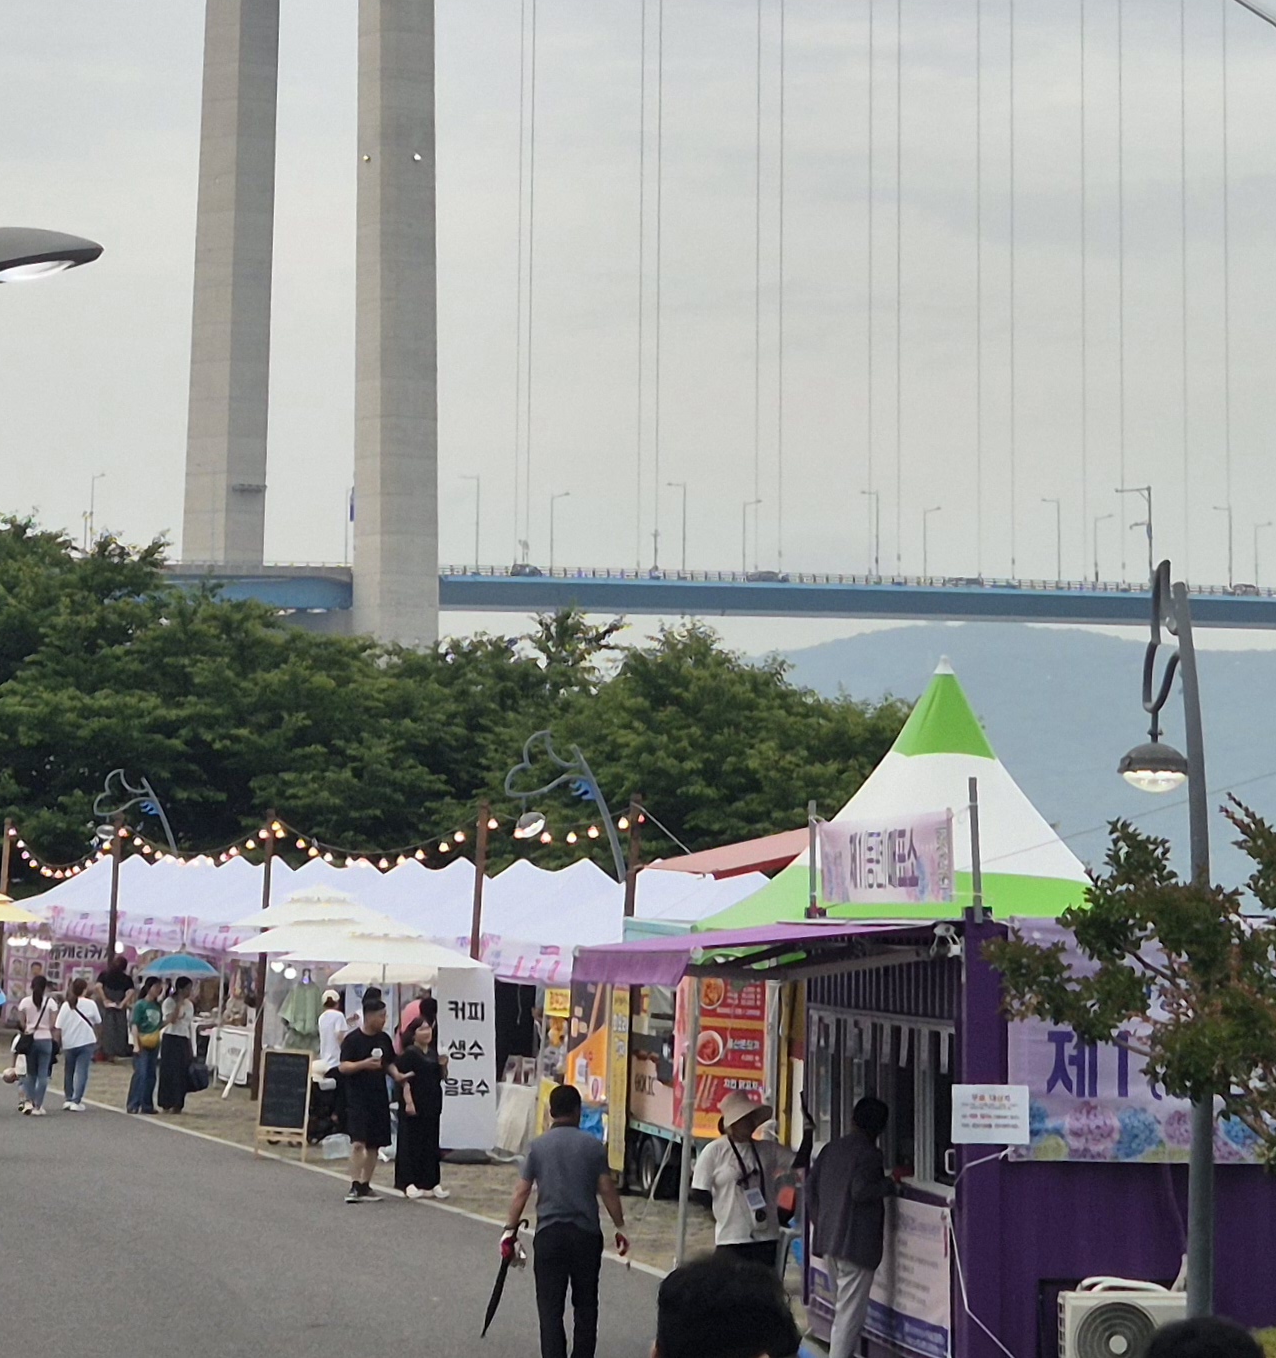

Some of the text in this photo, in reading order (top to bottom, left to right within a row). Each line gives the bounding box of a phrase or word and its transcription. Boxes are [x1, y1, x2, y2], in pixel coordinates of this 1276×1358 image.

[448, 1000, 484, 1021] 커피
[448, 1039, 485, 1060] 생수
[444, 1078, 490, 1097] 음료수
